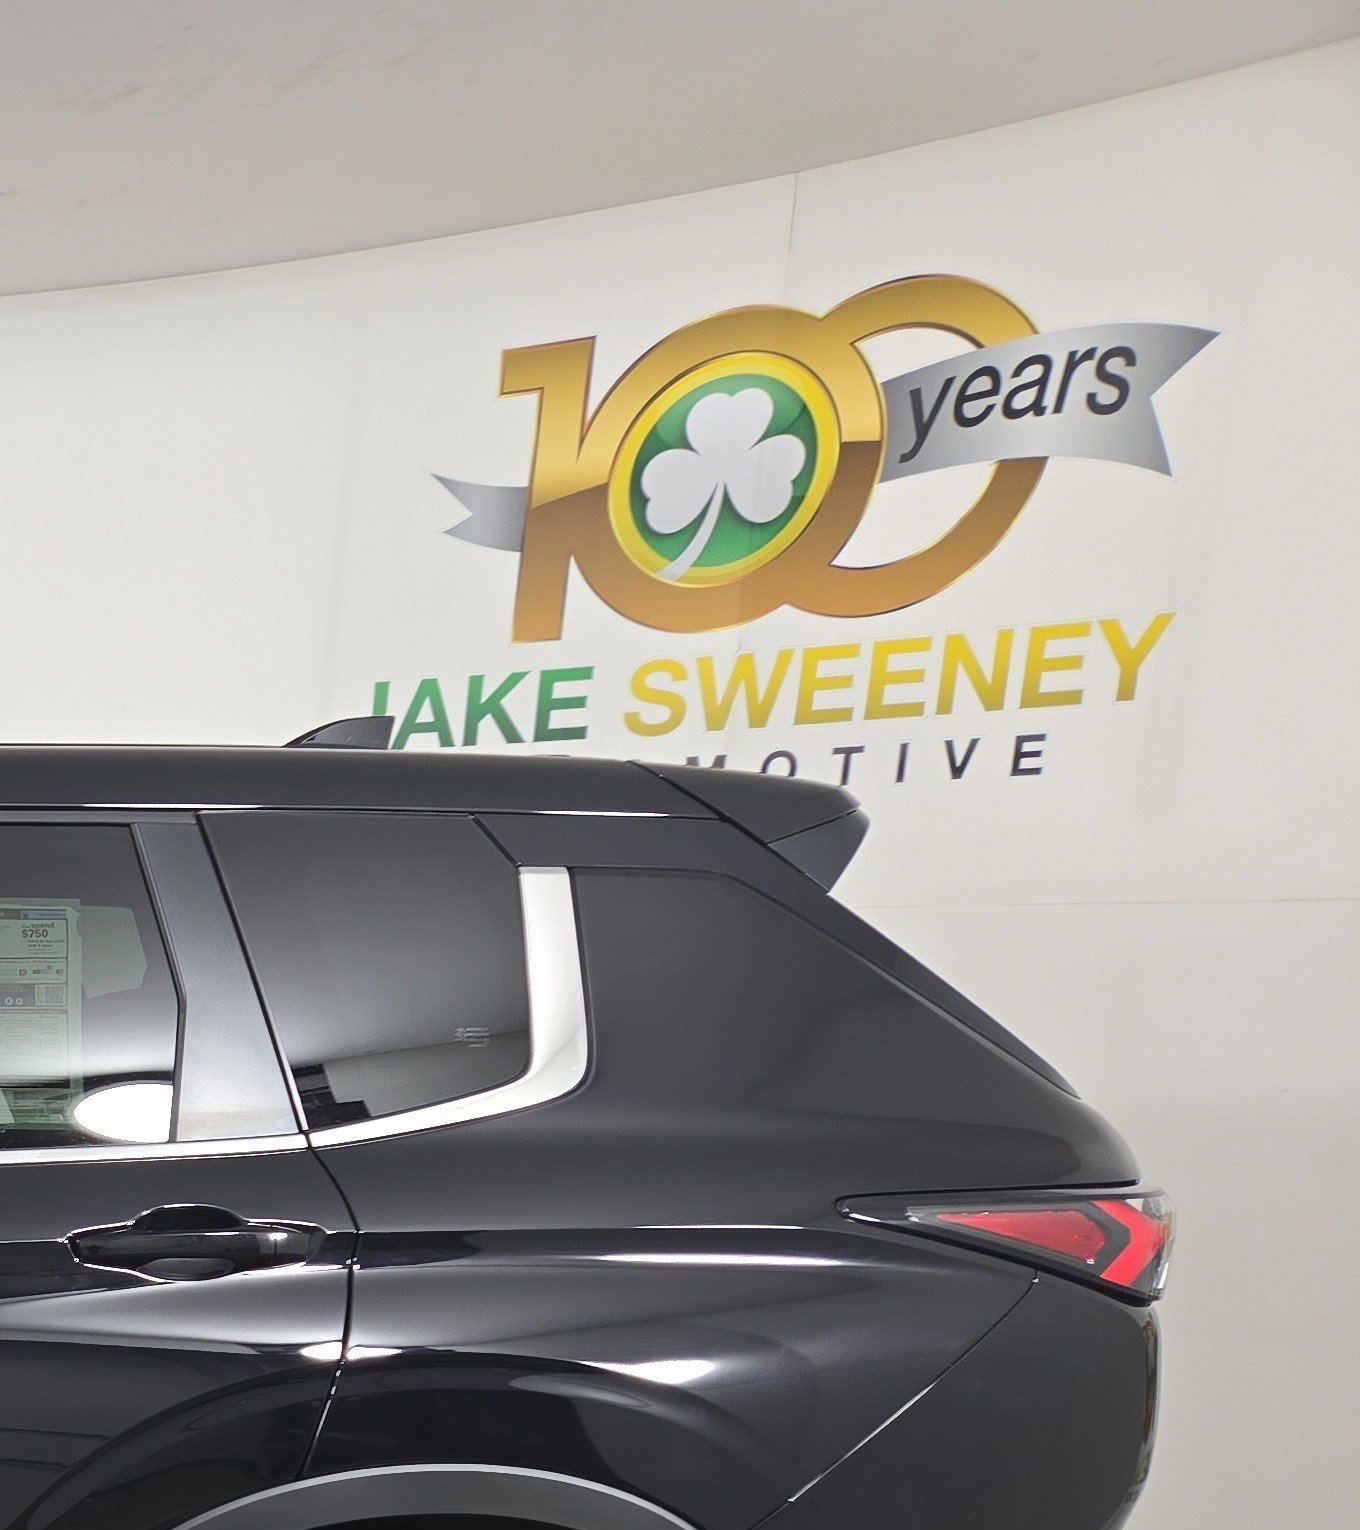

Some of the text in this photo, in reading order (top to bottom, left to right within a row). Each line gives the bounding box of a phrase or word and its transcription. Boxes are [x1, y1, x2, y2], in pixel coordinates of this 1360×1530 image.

[500, 273, 1049, 643] 100
[899, 344, 1138, 464] years
[622, 611, 1178, 738] SWEENEY
[684, 732, 1048, 787] OTIVE
[21, 929, 49, 939] $750
